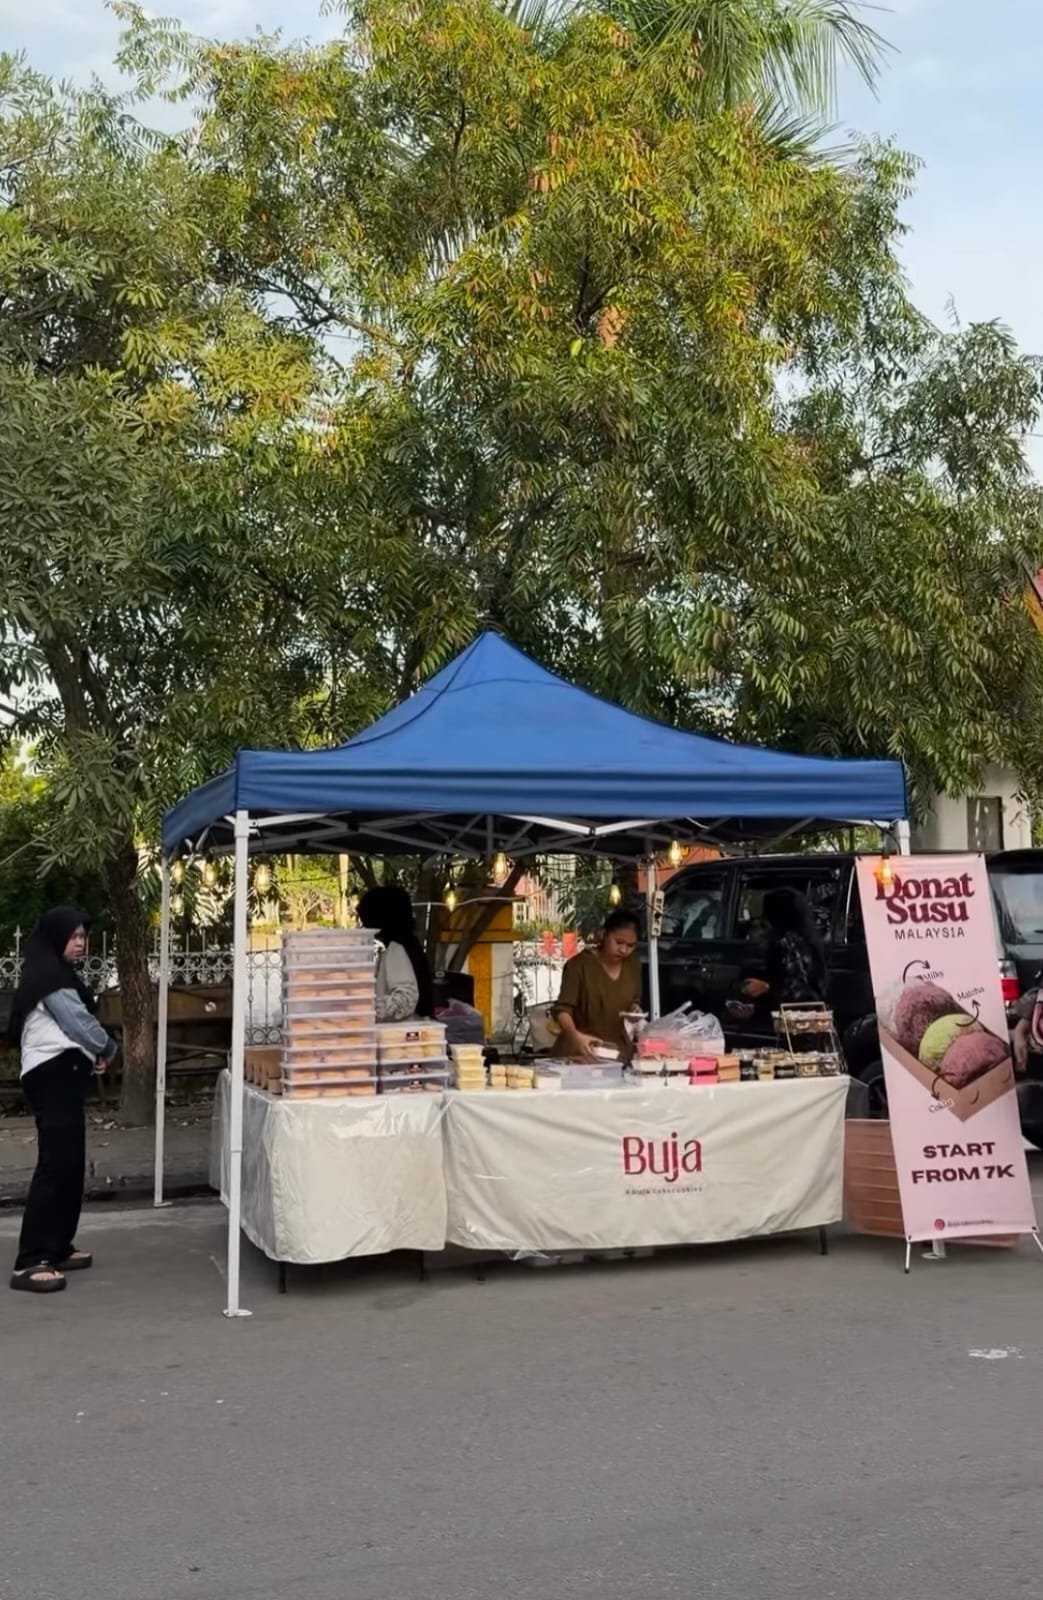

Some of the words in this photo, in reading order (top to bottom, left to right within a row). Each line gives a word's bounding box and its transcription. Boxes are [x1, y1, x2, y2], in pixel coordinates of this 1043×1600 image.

[873, 872, 975, 900] Donat
[886, 896, 969, 925] Susu
[895, 927, 965, 940] MALAYSIA
[923, 970, 944, 981] Milky
[957, 986, 985, 999] Matcha
[622, 1131, 702, 1183] Buja
[923, 1141, 996, 1159] START
[911, 1166, 980, 1185] FROM
[983, 1164, 1016, 1179] 7K
